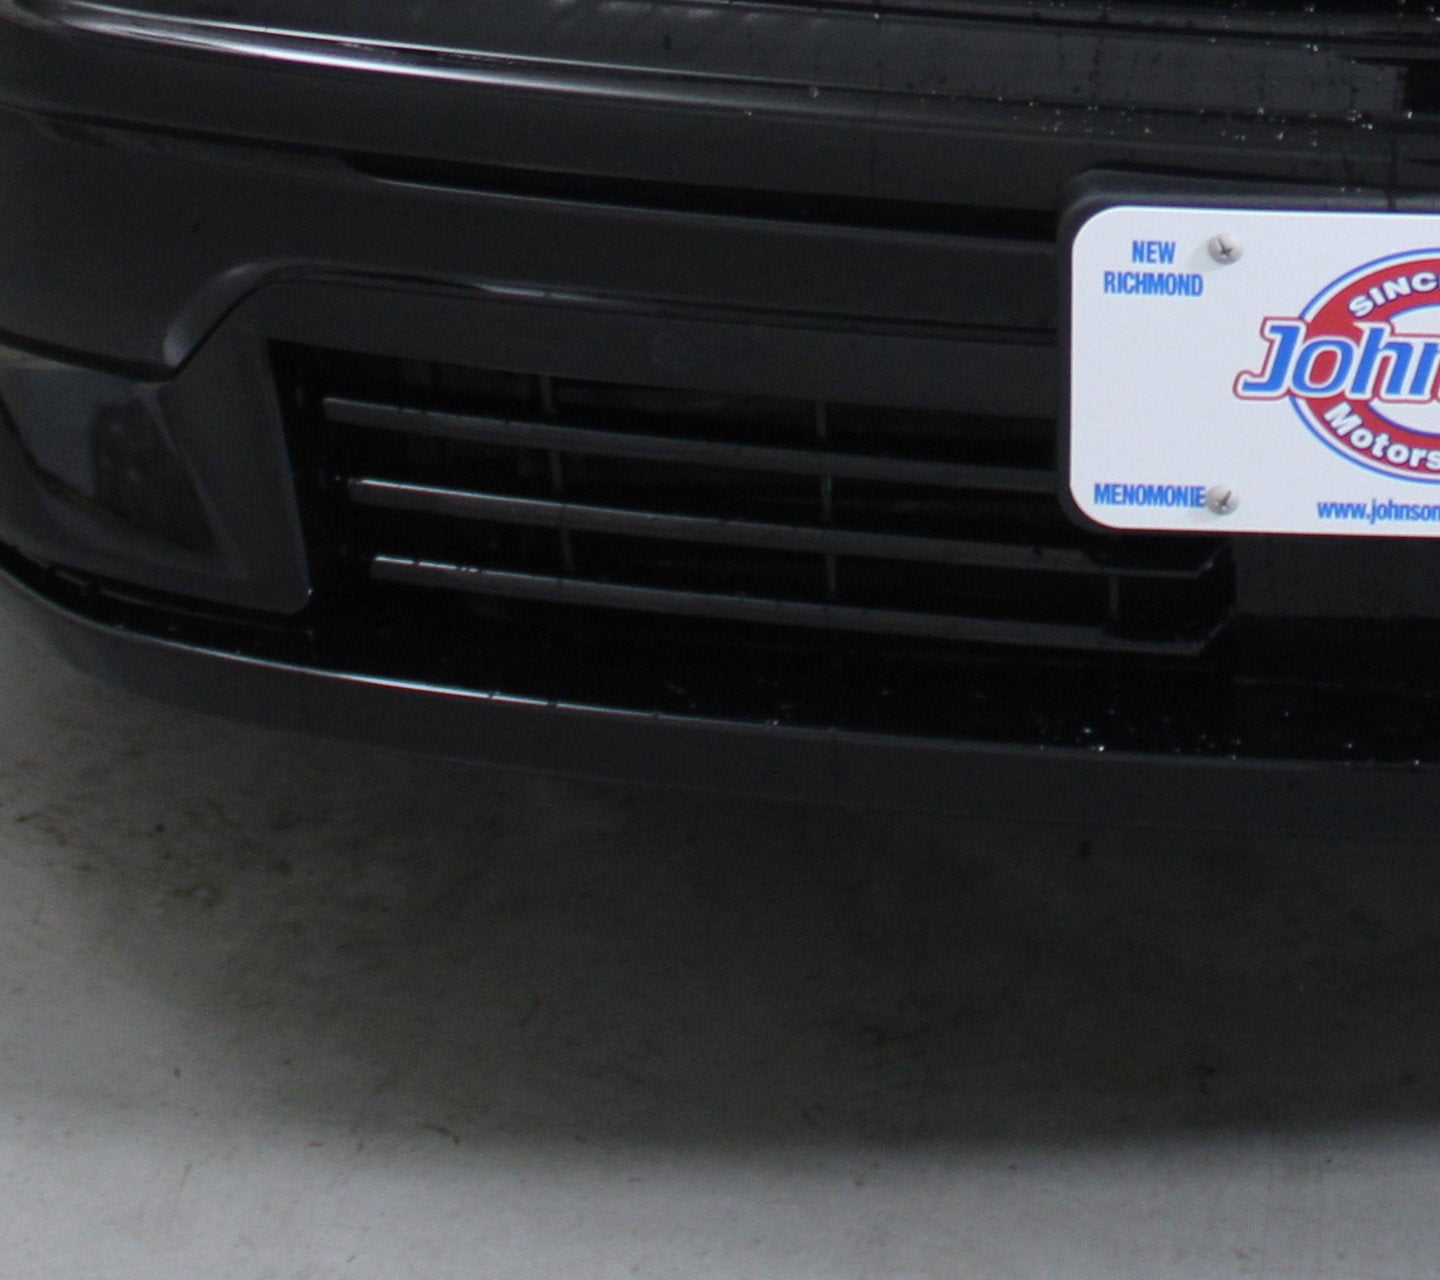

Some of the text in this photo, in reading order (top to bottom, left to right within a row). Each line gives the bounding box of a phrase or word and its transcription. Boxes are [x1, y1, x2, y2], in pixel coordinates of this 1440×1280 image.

[1131, 240, 1175, 264] NEW
[1103, 271, 1204, 296] RICHMOND
[1093, 483, 1206, 508] MENOMONIE
